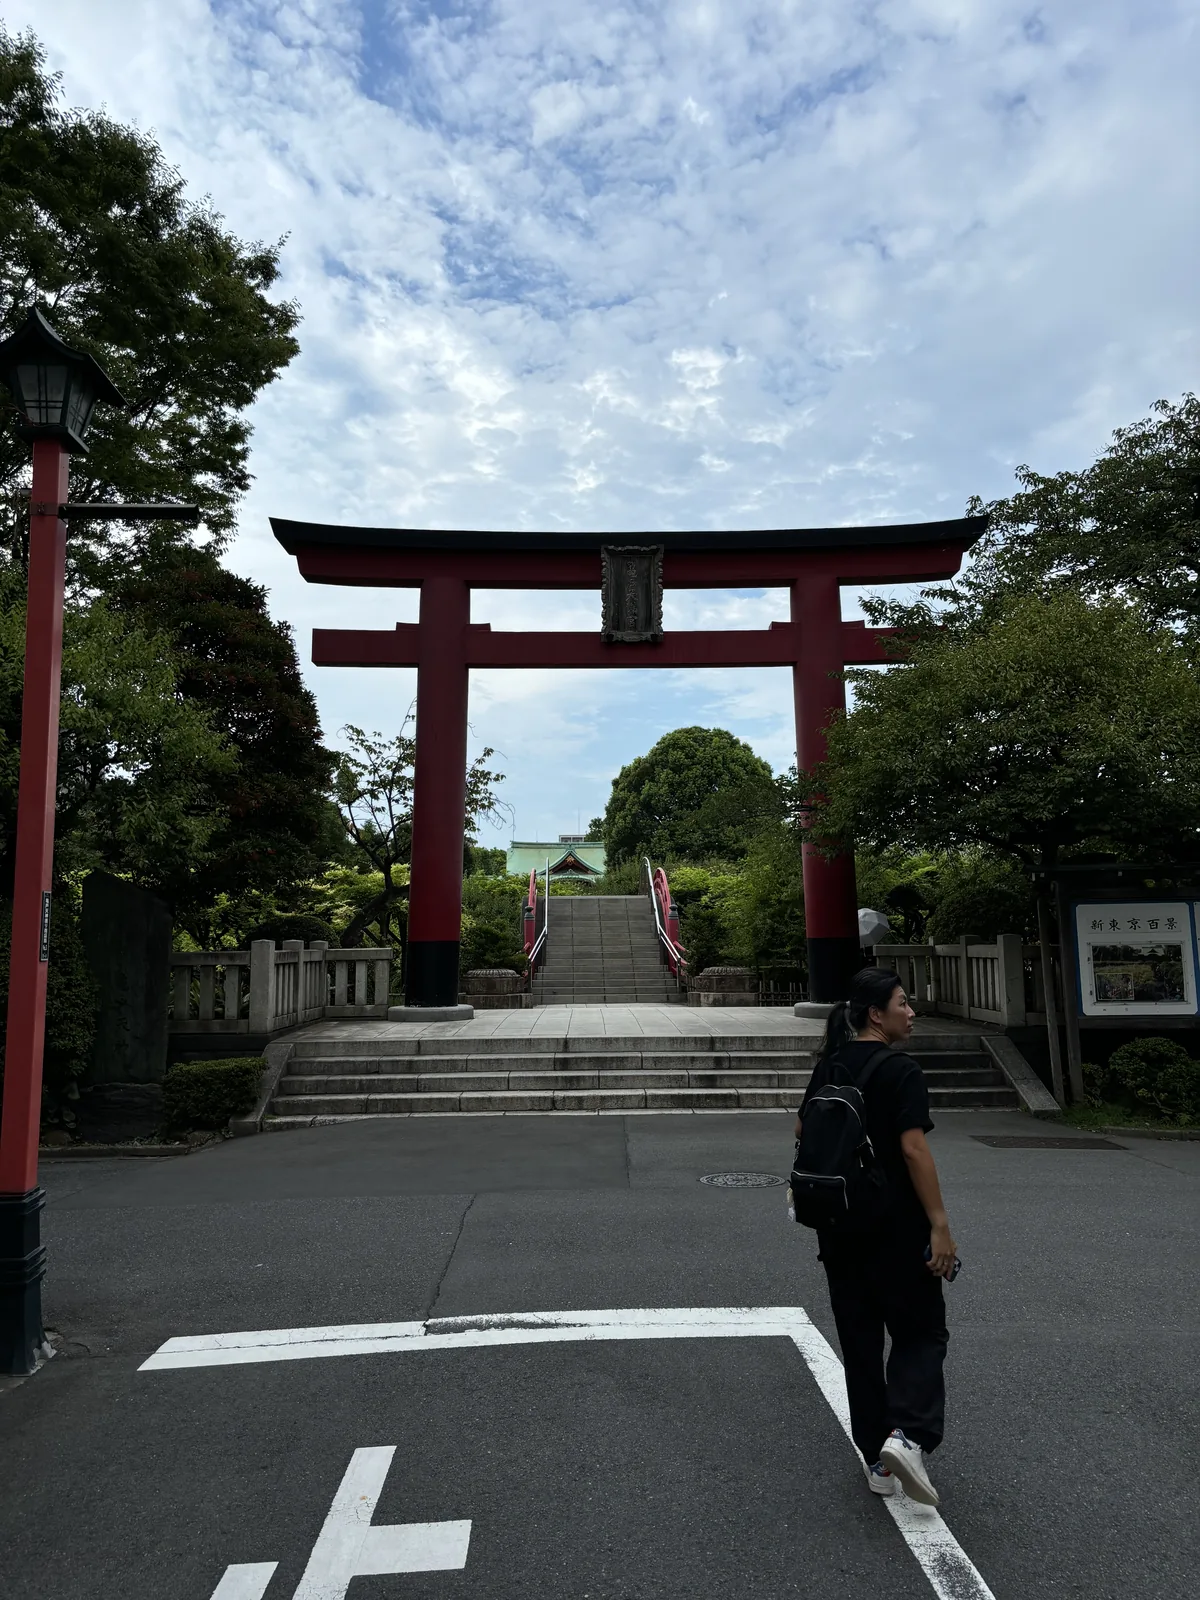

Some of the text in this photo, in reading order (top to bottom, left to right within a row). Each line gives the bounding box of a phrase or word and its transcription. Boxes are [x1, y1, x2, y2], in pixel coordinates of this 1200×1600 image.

[1090, 917, 1178, 932] 新東京百景
